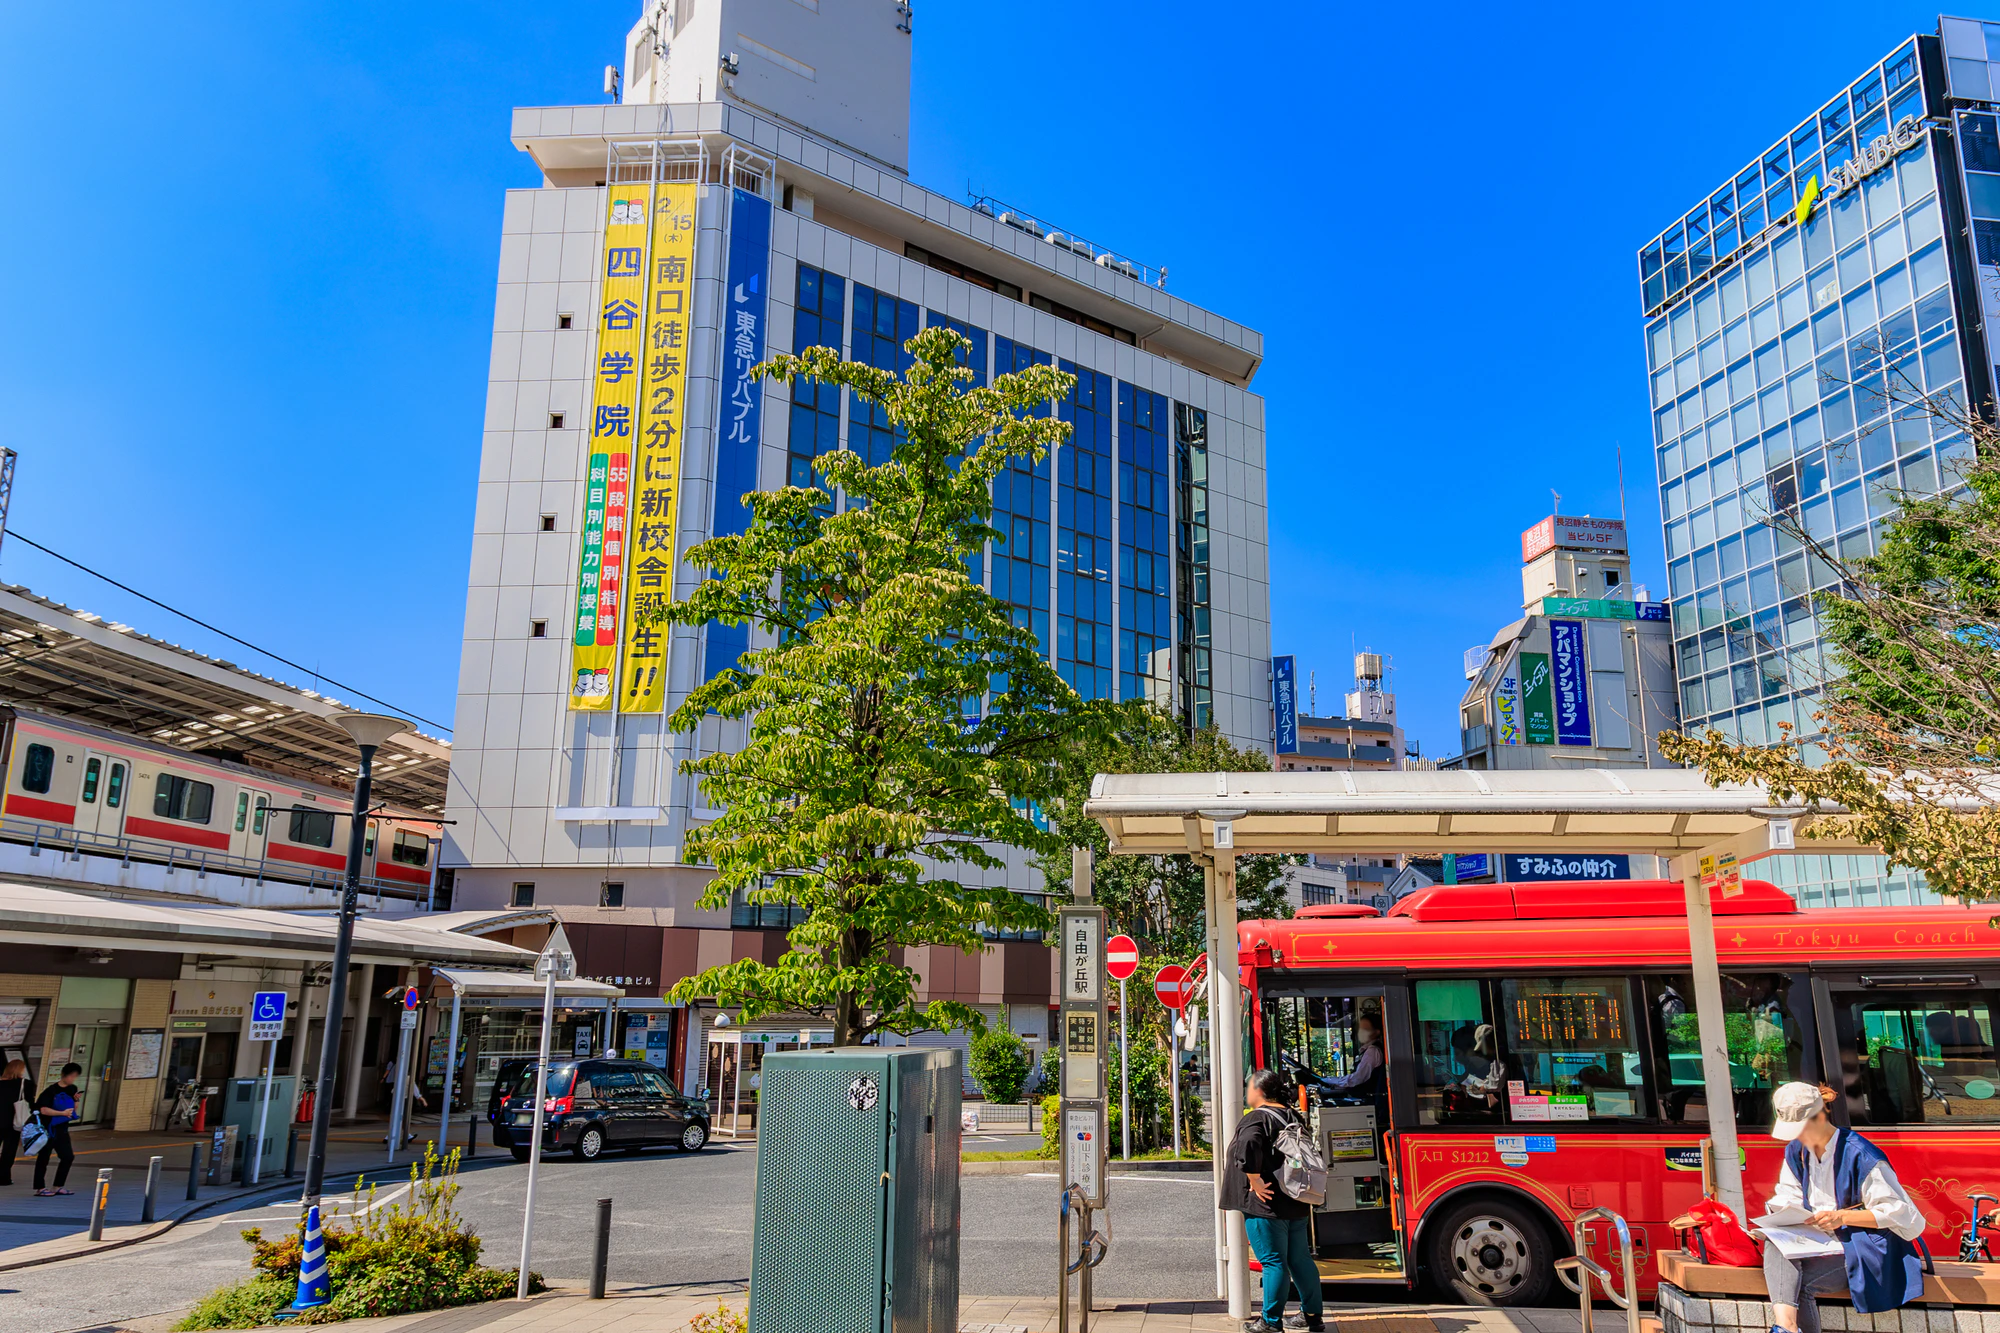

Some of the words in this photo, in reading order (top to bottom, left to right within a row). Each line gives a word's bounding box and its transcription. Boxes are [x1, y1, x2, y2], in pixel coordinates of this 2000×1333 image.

[1828, 114, 1916, 197] SMBC
[594, 247, 642, 438] 四谷学院
[728, 309, 757, 444] 東急リバブル
[1526, 521, 1550, 545] 長沼静
[1556, 517, 1624, 531] 長沼静きもの学院
[1567, 531, 1613, 543] 当ビル5F
[577, 467, 606, 631] 科目別能力別授業
[598, 467, 628, 631] 55段階個別指導
[1554, 600, 1590, 615] エイブル
[1503, 677, 1517, 689] 3F
[1523, 661, 1549, 698] エイブル
[1555, 626, 1578, 727] アパマンショップ
[1574, 656, 1583, 703] Communication
[1279, 680, 1294, 746] 東急リバブル
[1497, 695, 1518, 741] ビッグ
[1517, 856, 1617, 878] すみふの仲介
[1773, 929, 1860, 949] Tokyu
[1894, 925, 1977, 944] Coach
[1074, 929, 1089, 993] 自由が丘駅
[1420, 1150, 1443, 1162] 入口
[1451, 1150, 1490, 1164] S1212
